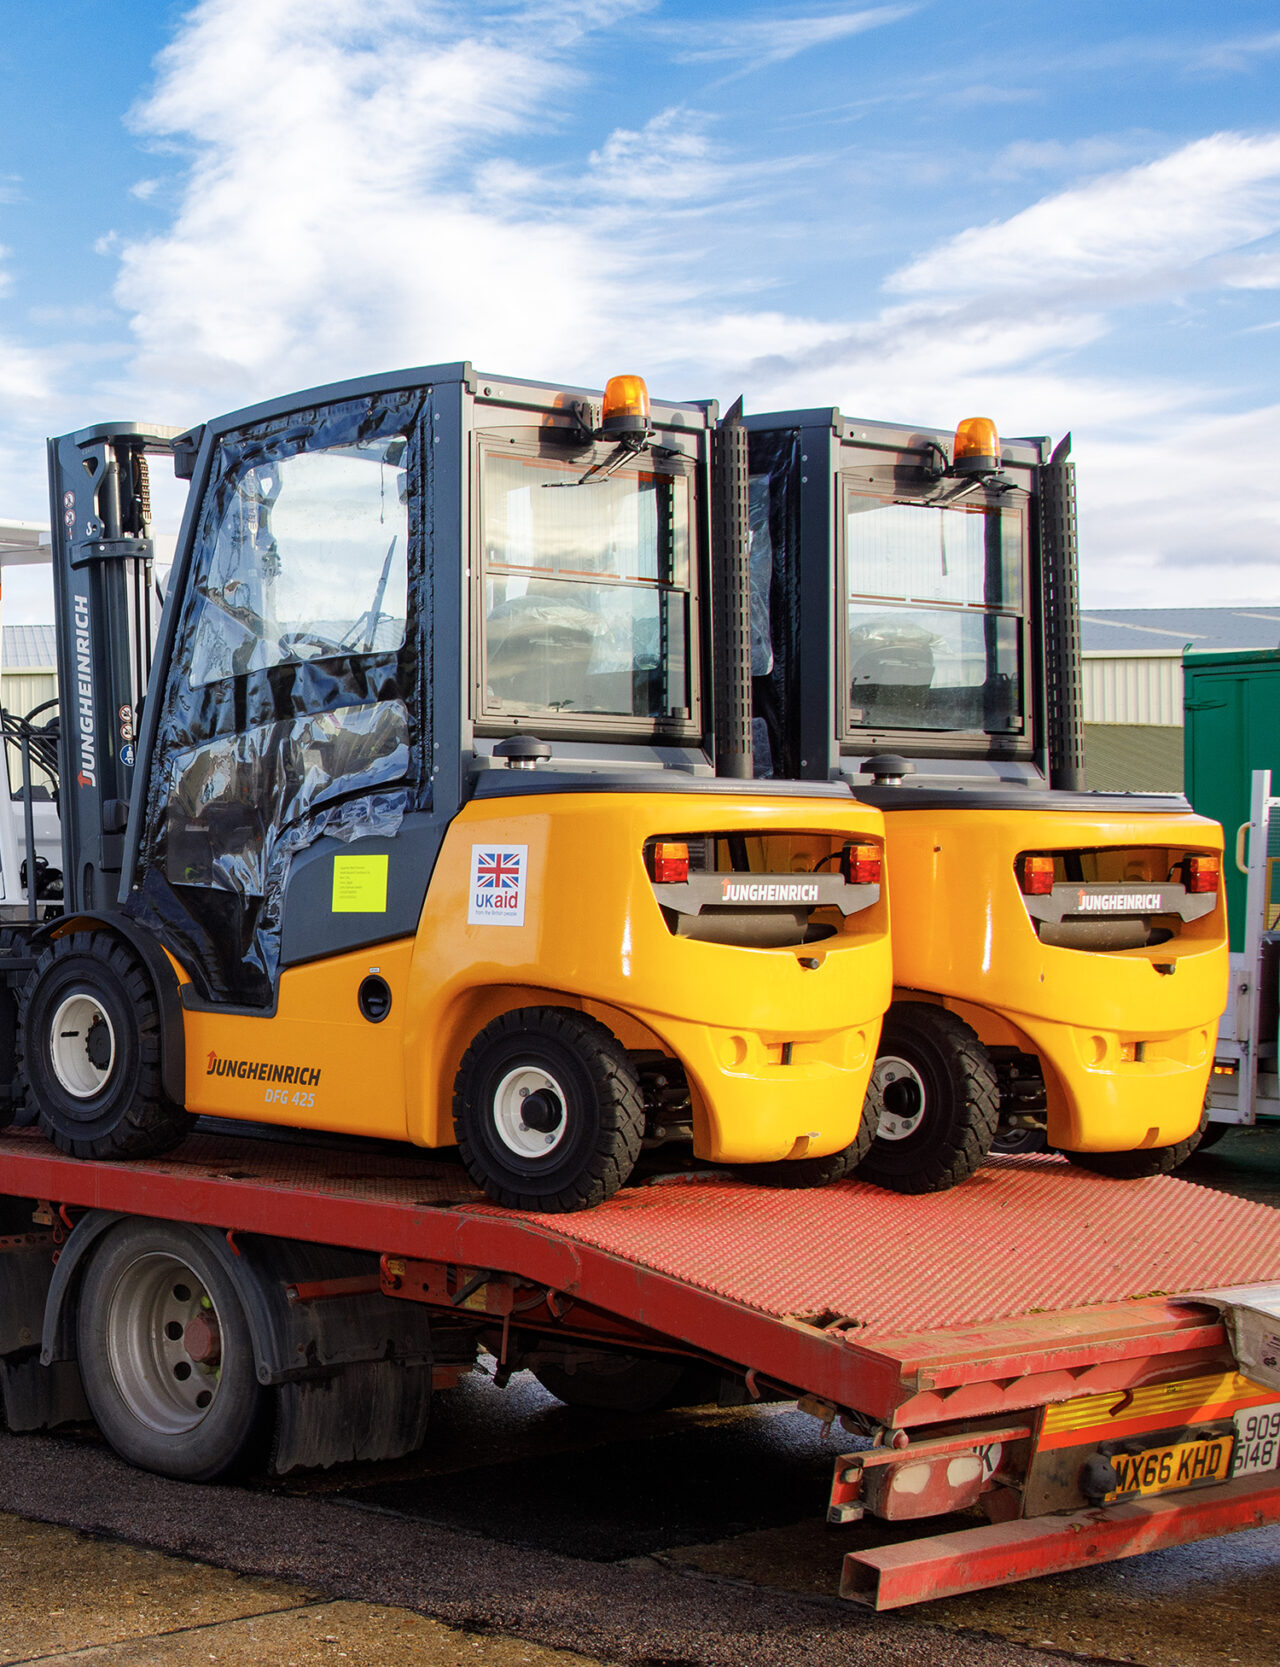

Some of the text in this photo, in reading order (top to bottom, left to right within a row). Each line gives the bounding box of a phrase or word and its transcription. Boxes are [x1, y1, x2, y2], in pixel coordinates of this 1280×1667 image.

[74, 594, 97, 788] JUNGHEINRICH
[722, 884, 819, 901] JUNGHEINRICH
[1078, 893, 1161, 910] JUNGHEINRICH
[206, 1057, 322, 1087] JUNGHEINRICH
[264, 1088, 317, 1108] DFG 425
[1115, 1443, 1223, 1492] MX66 KHD
